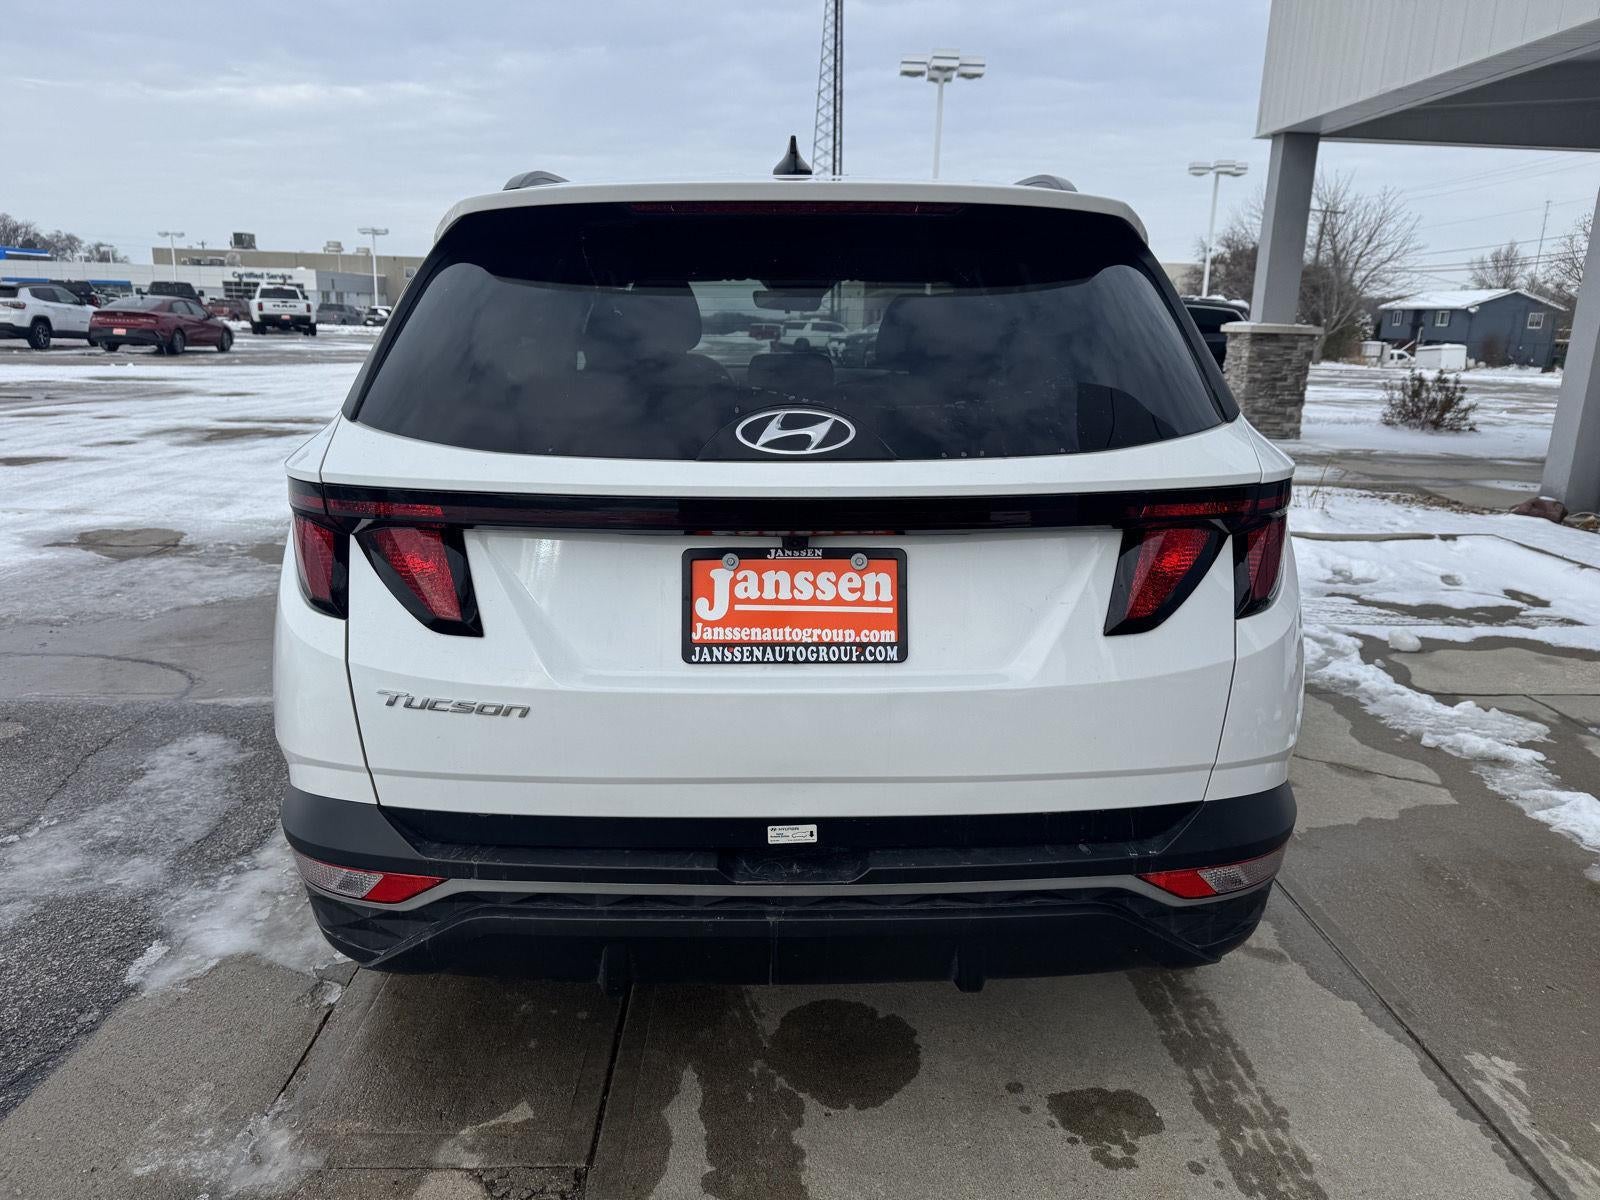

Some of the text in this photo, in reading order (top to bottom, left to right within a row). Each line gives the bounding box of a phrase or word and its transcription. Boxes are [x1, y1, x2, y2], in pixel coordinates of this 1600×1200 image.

[232, 271, 293, 280] Certified Service
[767, 549, 822, 559] JANSSEN
[695, 568, 893, 621] Janssen
[692, 623, 896, 643] Janssenautogroup.com
[691, 645, 898, 662] JANSSENAUTOGROUP.COM
